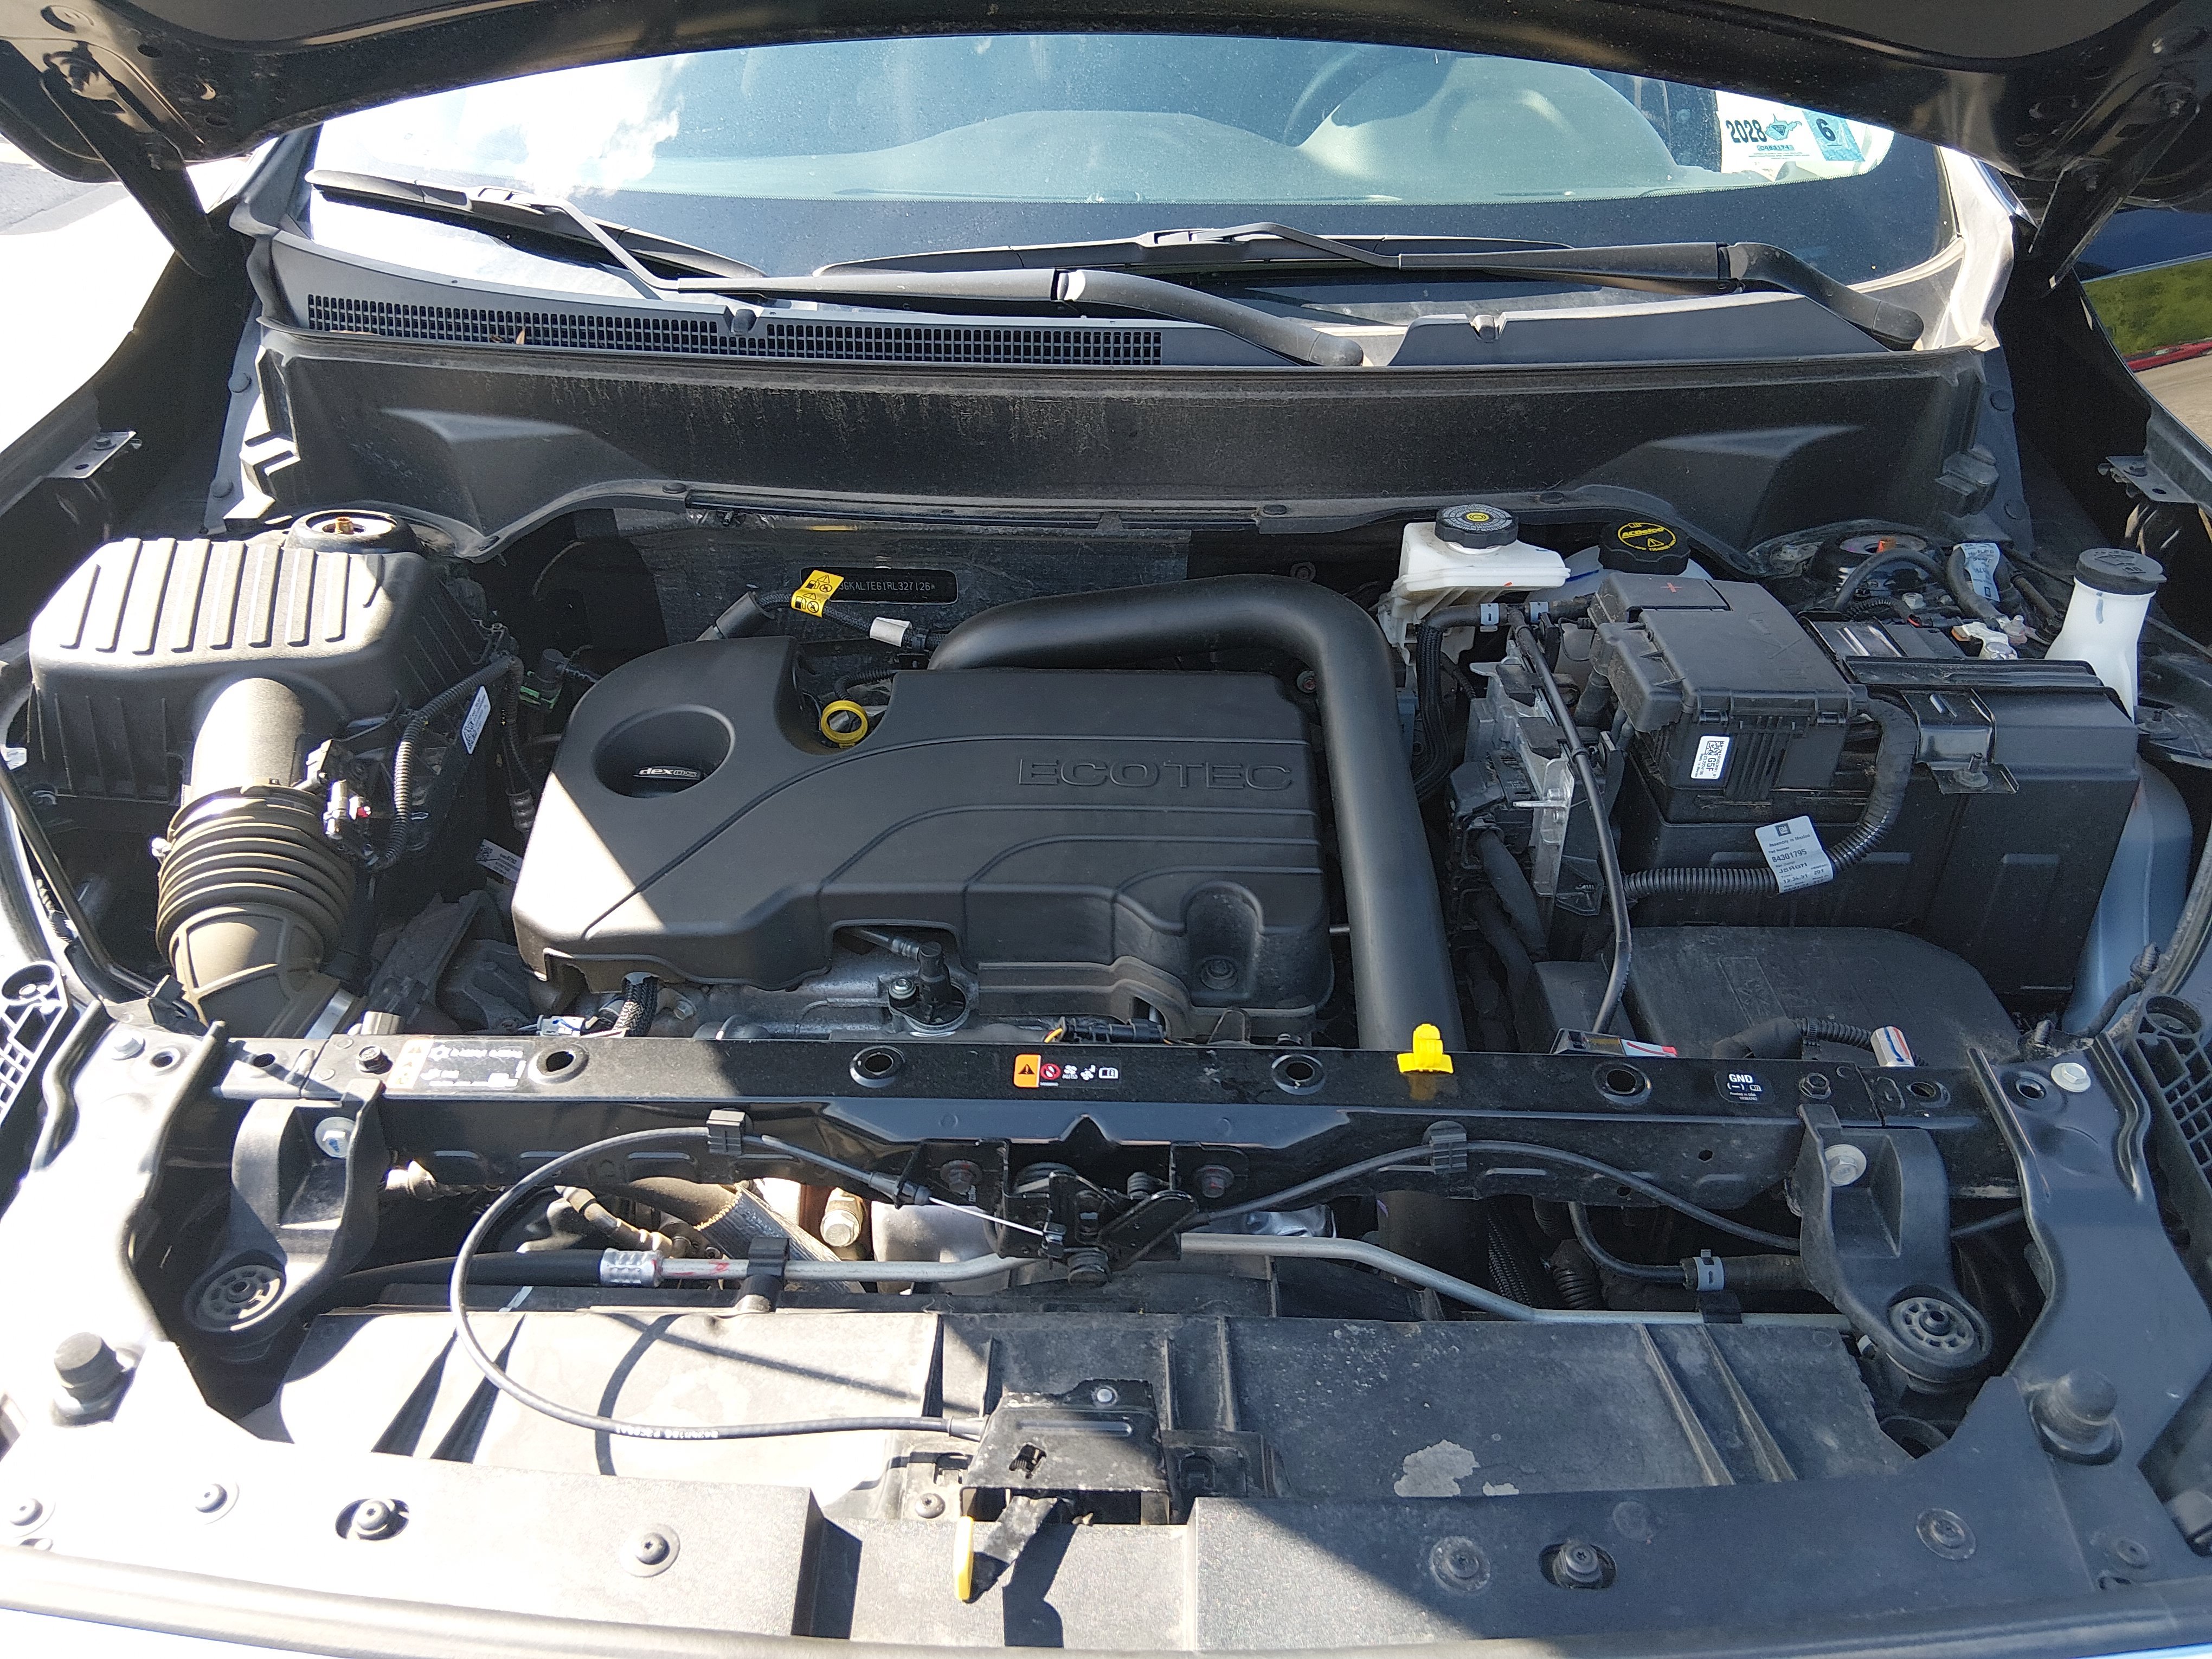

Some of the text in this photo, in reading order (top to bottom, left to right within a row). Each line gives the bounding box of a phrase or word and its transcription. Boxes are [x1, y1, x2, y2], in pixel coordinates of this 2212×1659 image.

[1726, 119, 1767, 143] 2028
[1816, 118, 1836, 142] 6
[1705, 757, 1716, 771] G5F
[639, 768, 698, 777] dexos
[1018, 758, 1293, 790] ECOTEC
[1771, 848, 1808, 863] 84301795
[1728, 1073, 1753, 1083] GND
